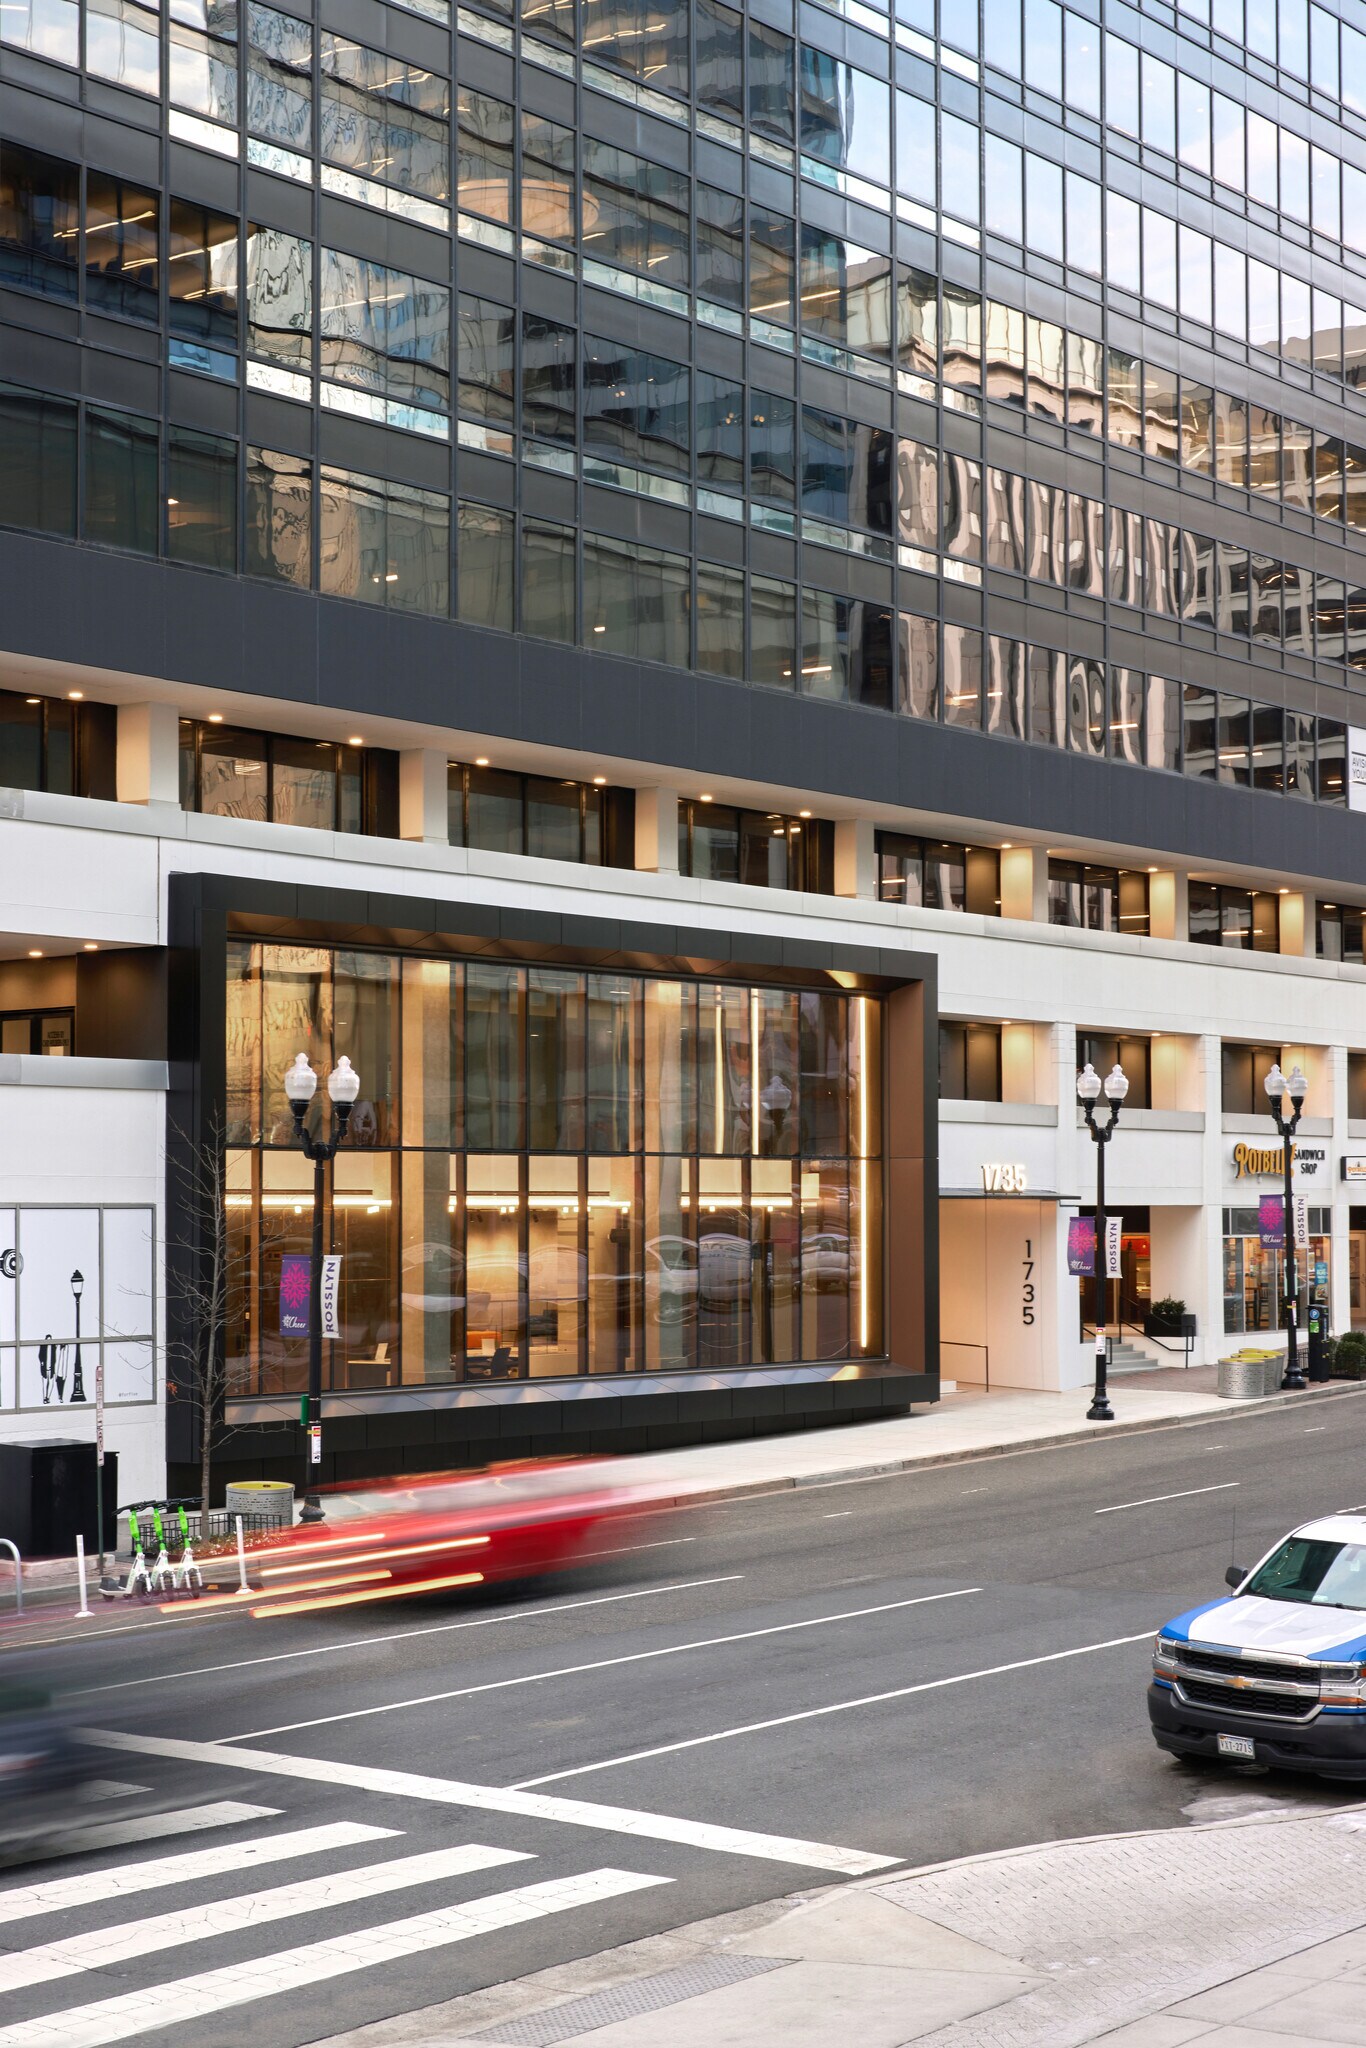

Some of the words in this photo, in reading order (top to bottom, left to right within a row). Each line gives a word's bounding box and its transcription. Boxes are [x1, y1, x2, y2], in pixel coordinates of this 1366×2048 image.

[1294, 1149, 1326, 1161] SANDWICH
[1300, 1162, 1318, 1175] SHOP
[981, 1164, 1027, 1193] 1735
[1297, 1198, 1306, 1243] ROSSLYN
[1109, 1223, 1118, 1272] ROSSLYN
[324, 1262, 336, 1333] ROSSLYN
[1022, 1239, 1035, 1325] 1735
[288, 1316, 306, 1329] Cheer
